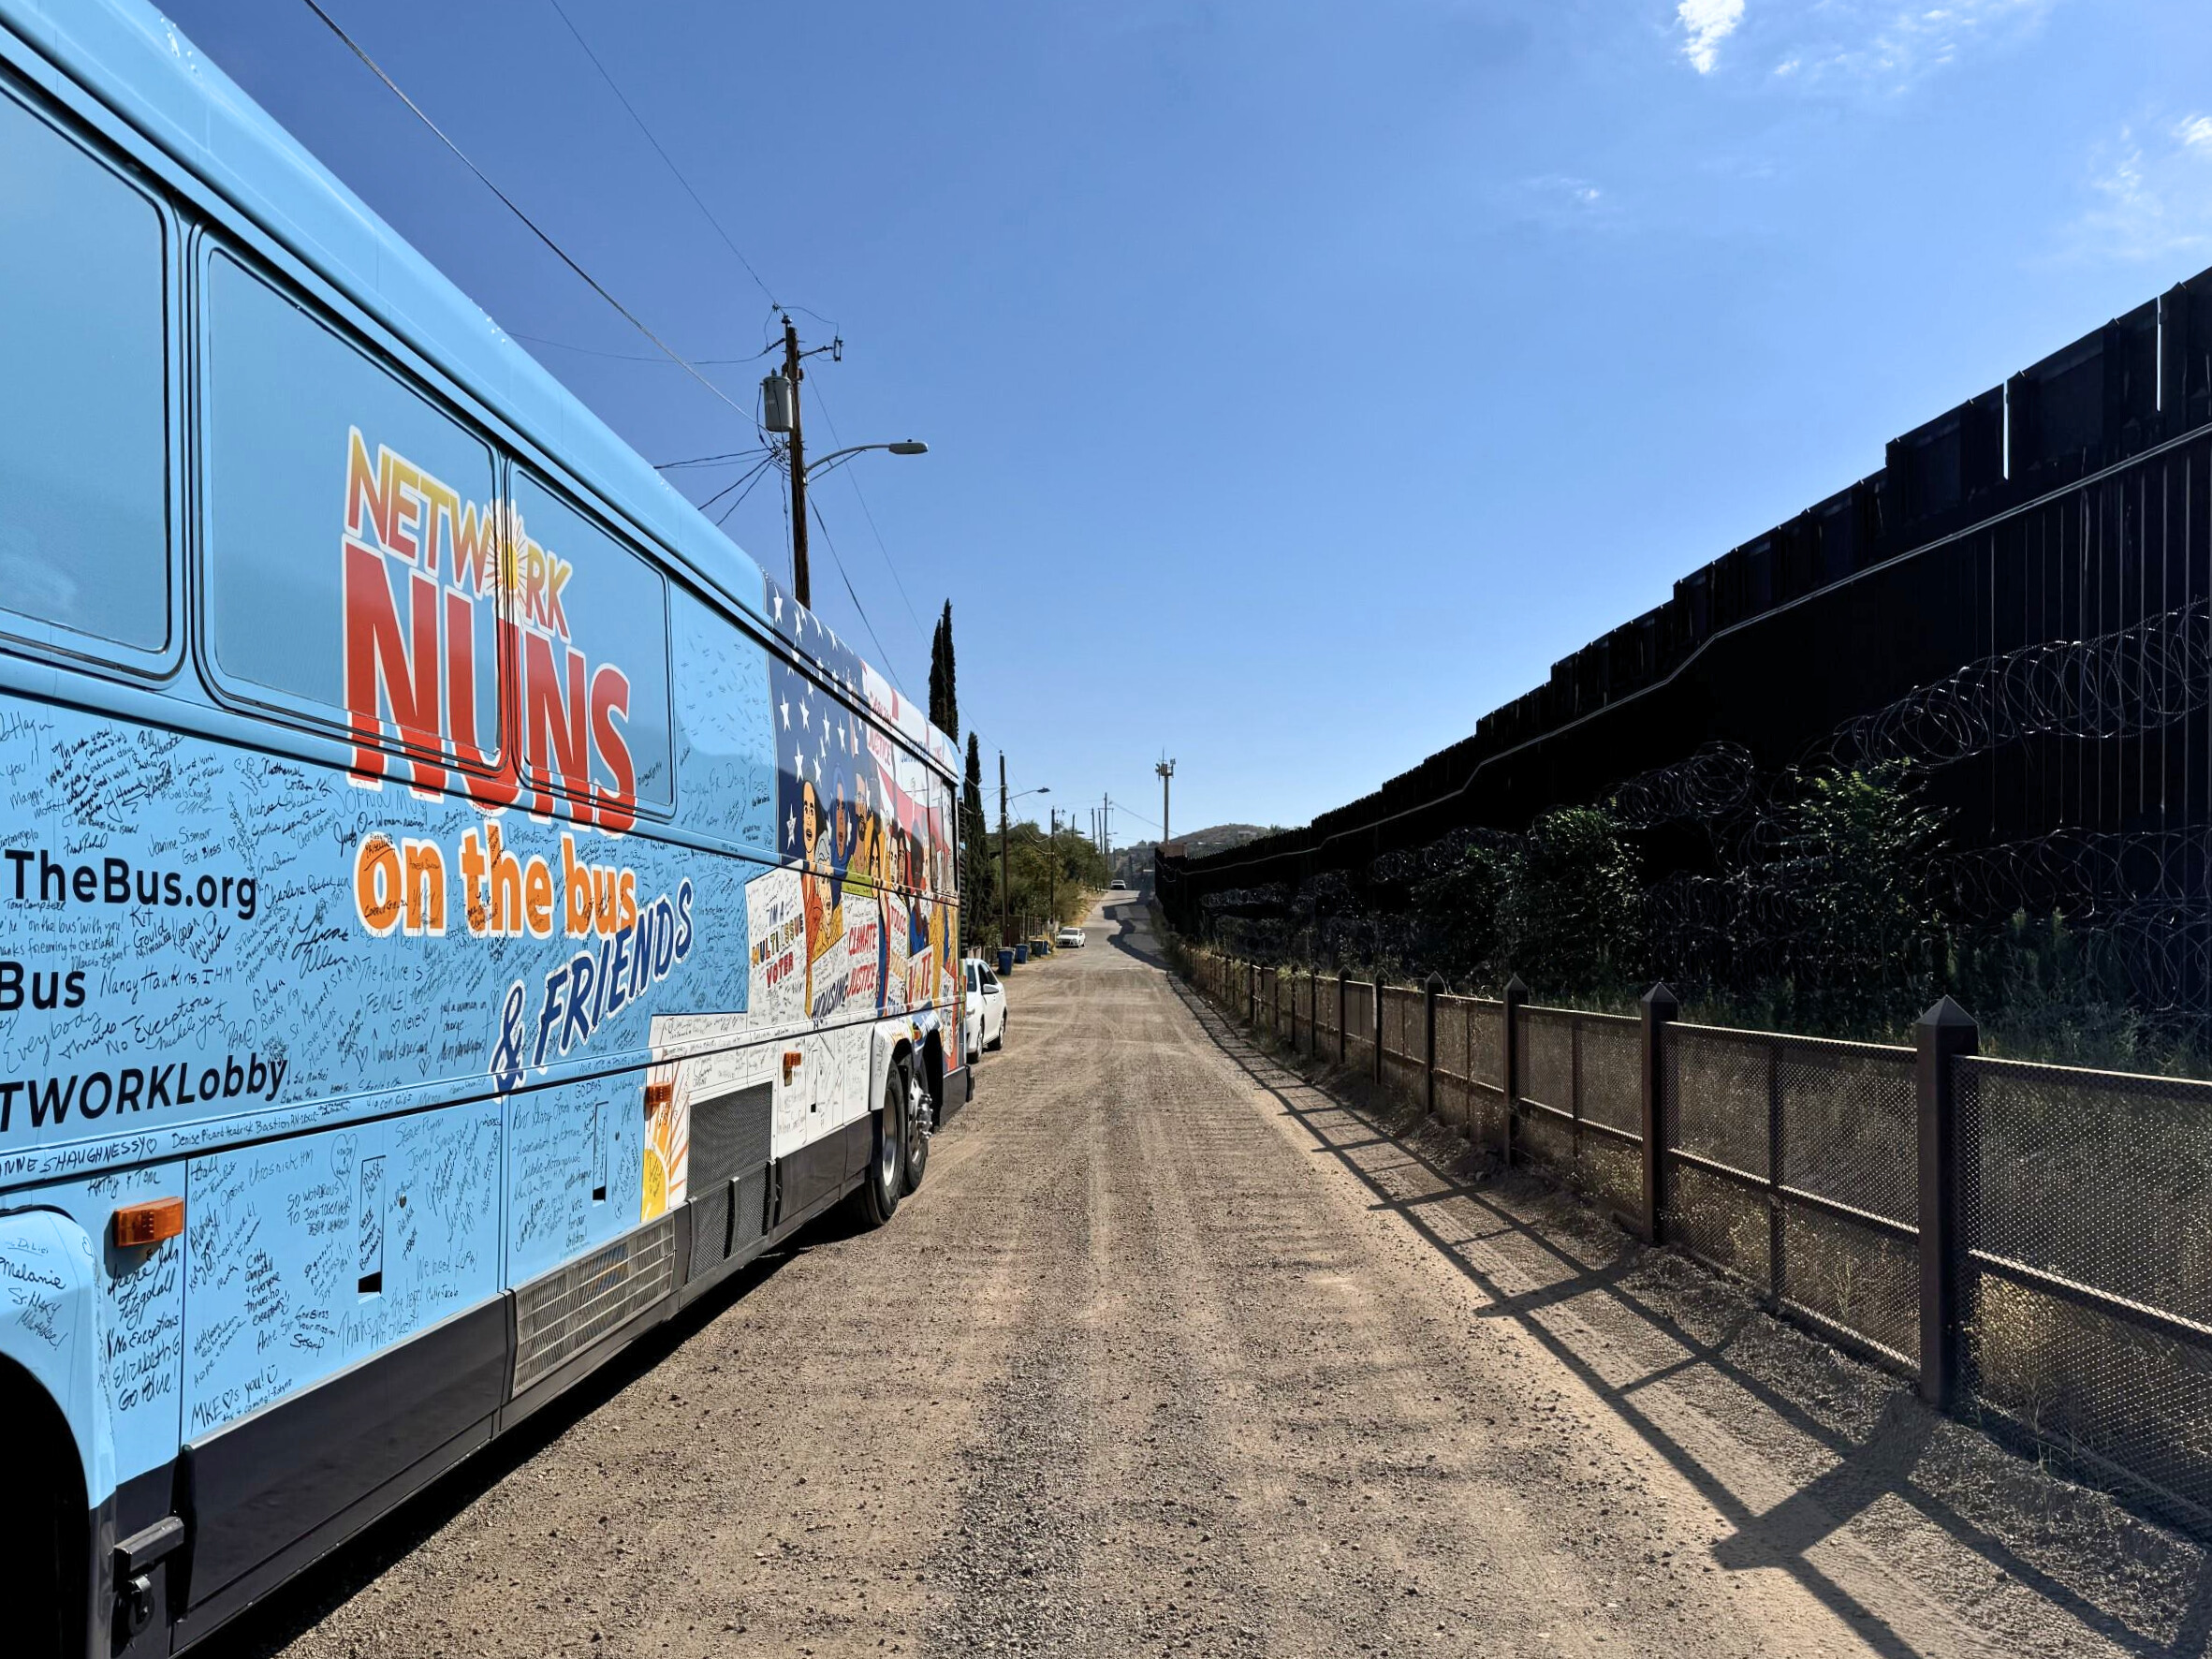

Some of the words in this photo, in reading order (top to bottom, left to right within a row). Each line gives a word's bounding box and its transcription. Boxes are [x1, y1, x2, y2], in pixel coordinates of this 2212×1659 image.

[343, 535, 637, 835] NUNS
[182, 848, 199, 866] God
[4, 849, 256, 920] TheBus.org
[356, 832, 446, 937] on
[460, 820, 553, 938] the
[562, 832, 637, 938] bus
[129, 904, 154, 928] Kit
[849, 922, 877, 956] CLIMATE
[0, 962, 85, 1011] Bus
[99, 966, 139, 1006] Nancy
[766, 951, 793, 989] VOTER
[846, 962, 877, 998] JUSTICE
[490, 979, 528, 1103] &
[535, 878, 694, 1073] FRIENDS
[106, 1039, 129, 1056] No
[0, 1052, 287, 1133] TWORKLobby
[39, 1135, 146, 1175] SHAUGHNESSY
[0, 1256, 66, 1290] Melanie
